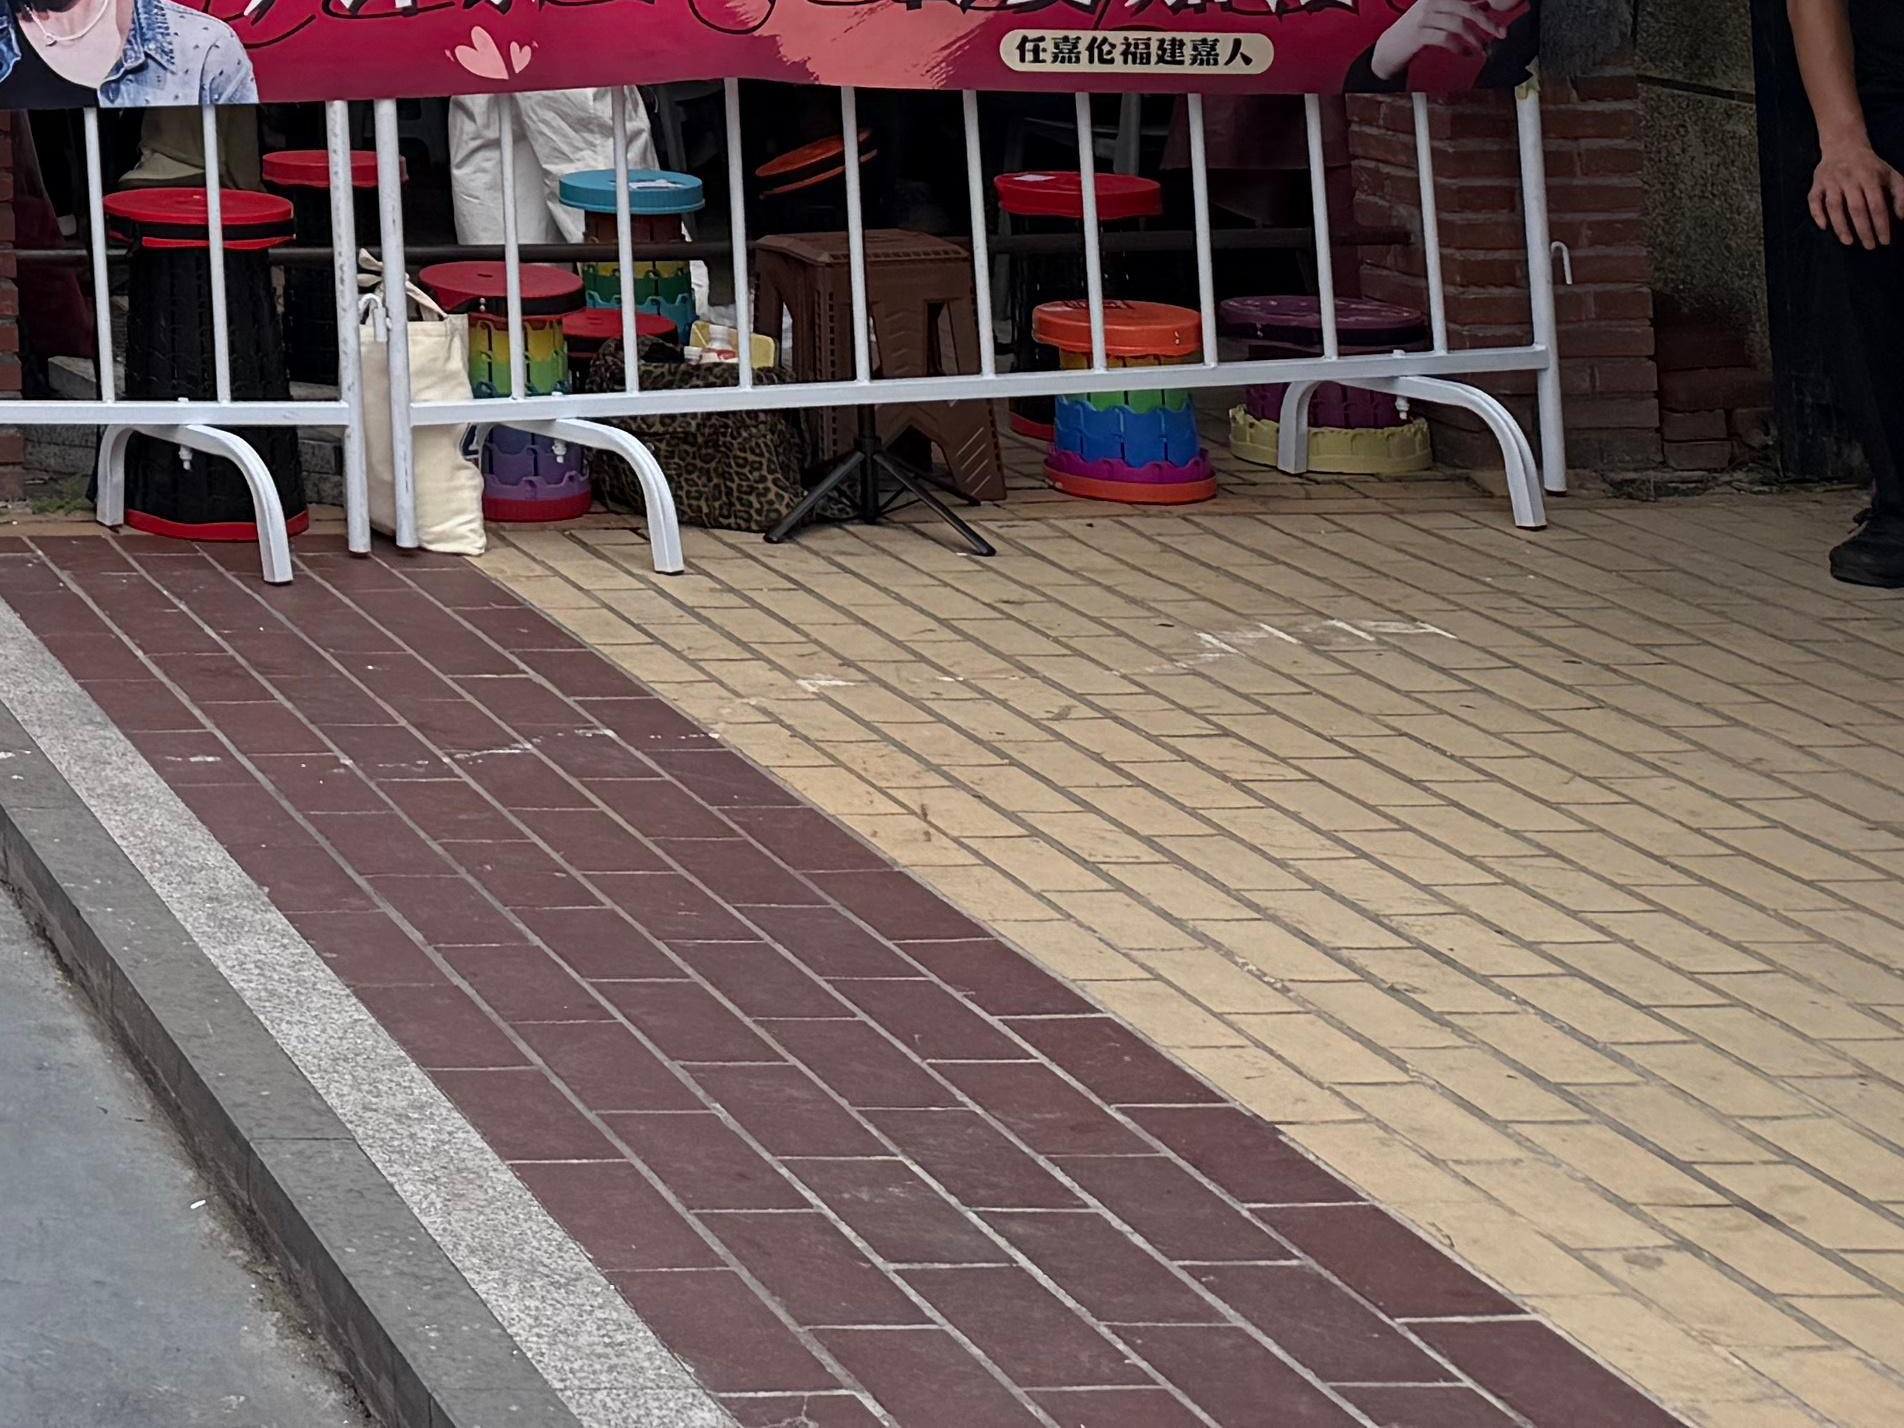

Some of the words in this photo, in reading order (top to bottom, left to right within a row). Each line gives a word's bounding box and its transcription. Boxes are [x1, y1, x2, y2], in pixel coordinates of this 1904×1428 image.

[1014, 33, 1255, 68] 任嘉伦福建嘉人
